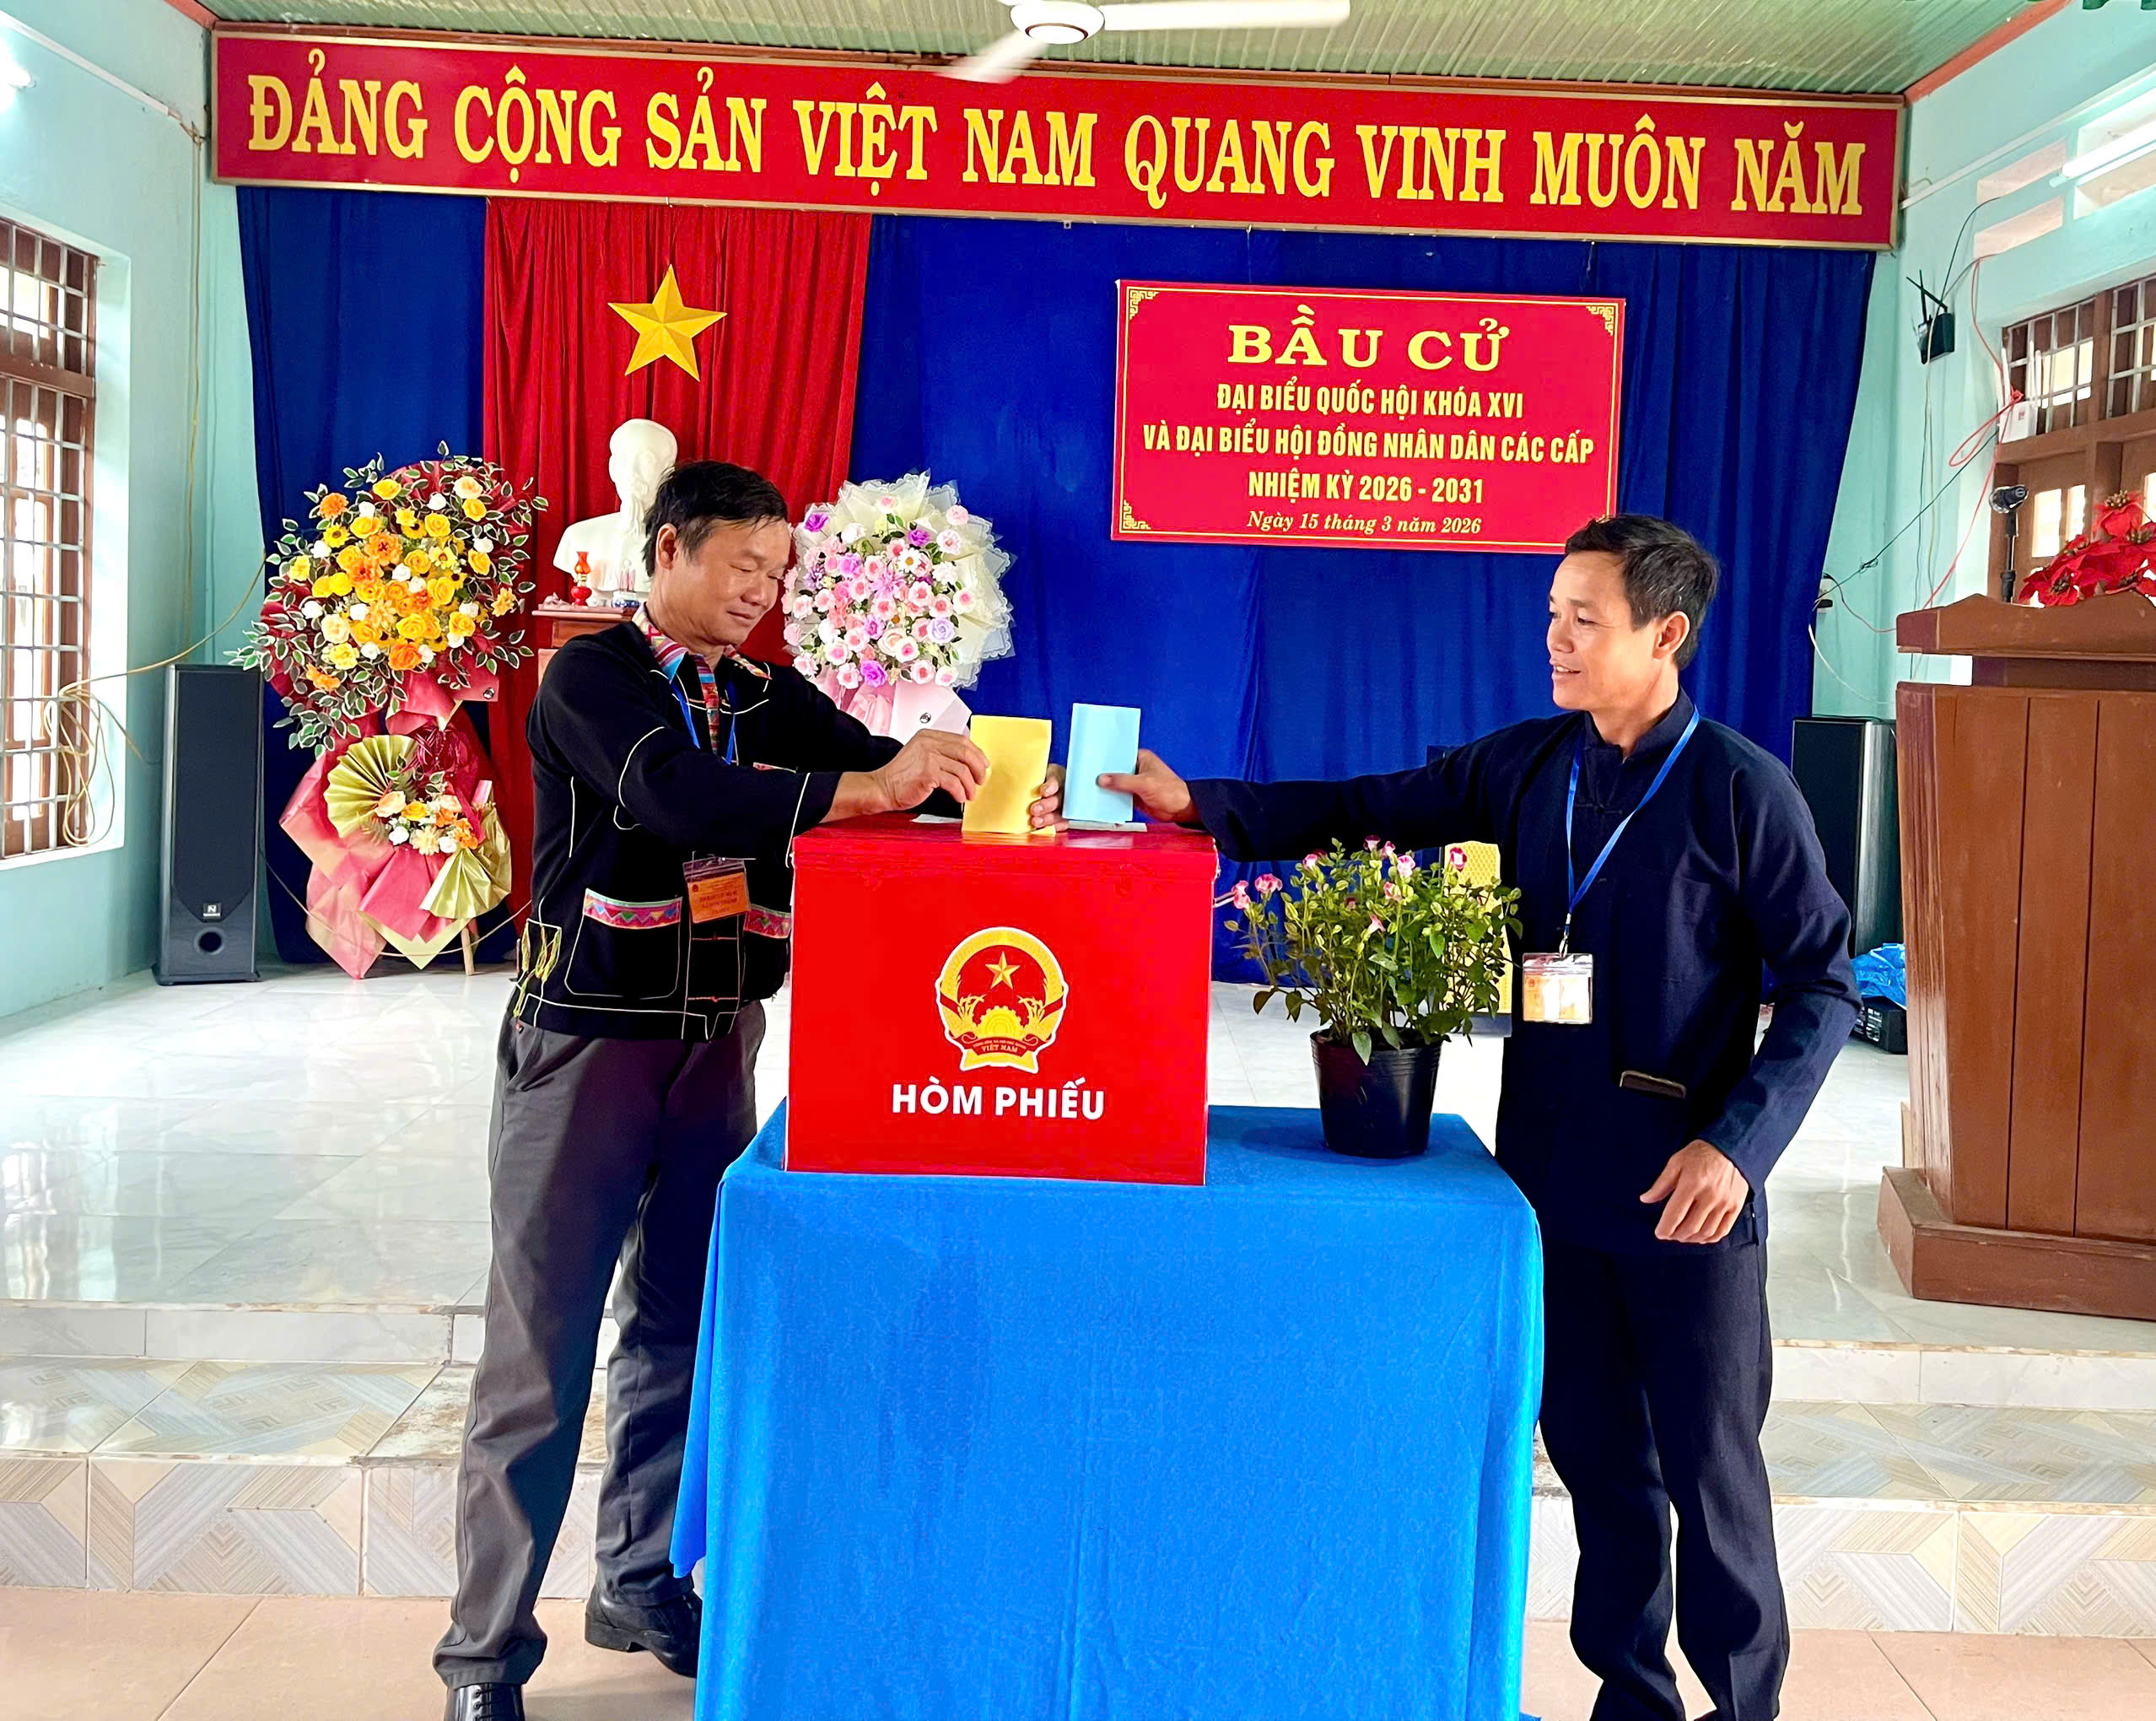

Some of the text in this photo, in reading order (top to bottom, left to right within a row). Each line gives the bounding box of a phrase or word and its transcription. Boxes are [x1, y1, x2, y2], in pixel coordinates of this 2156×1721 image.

[249, 49, 1865, 214] ĐẢNG CỘNG SẢN VIỆT NAM QUANG VINH MUÔN NĂM
[1228, 305, 1509, 371] BẦU CỬ
[1217, 376, 1523, 420] ĐẠI BIỂU QUỐC HỘI KHÓA XVI
[1144, 418, 1593, 463] VÀ ĐẠI BIỂU HỘI ĐỒNG NHÂN DÂN CÁC CẤP
[1249, 467, 1320, 498] NHIỆM
[1327, 470, 1354, 499] KỲ
[1359, 476, 1411, 501] 2026
[1432, 477, 1482, 503] 2031
[1247, 511, 1481, 535] Ngày 15 tháng 3 năm 2026
[1000, 1044, 1018, 1053] NAM
[893, 1076, 1103, 1119] HÒM PHIẾU
